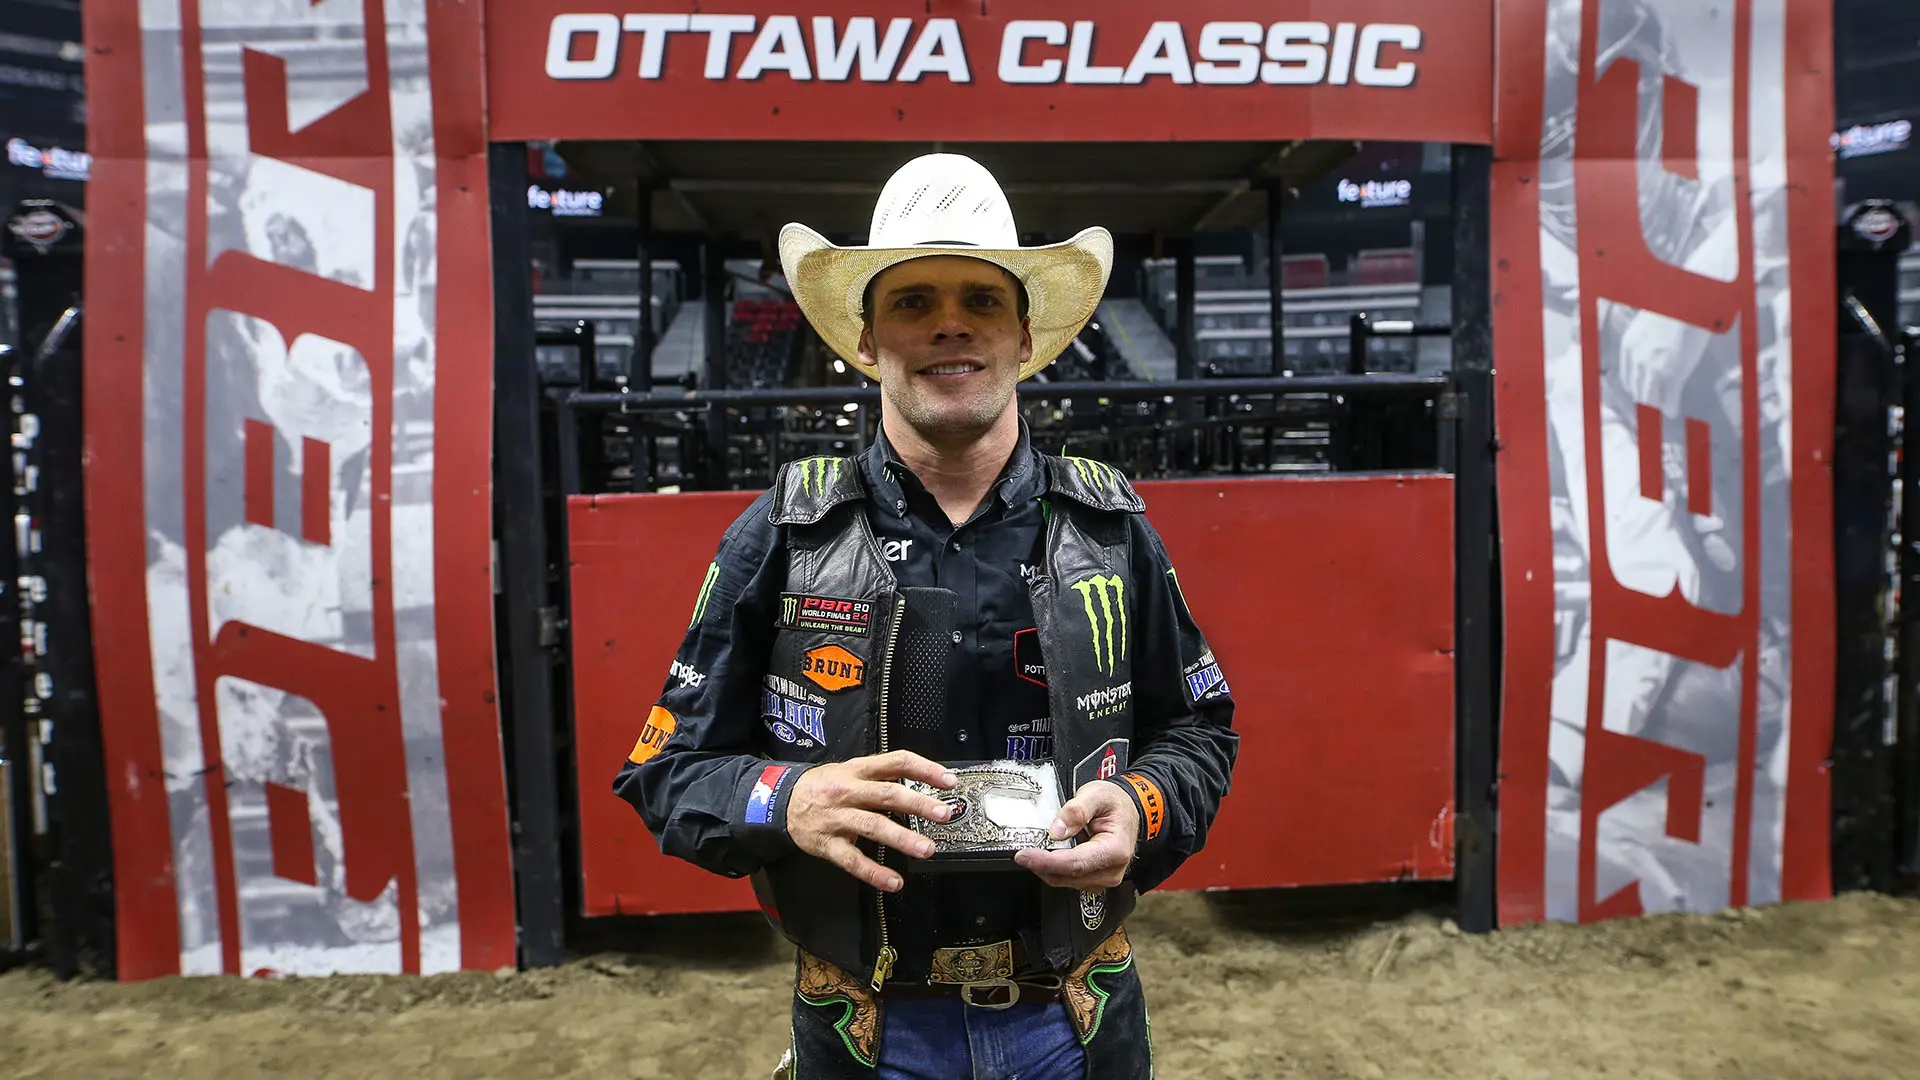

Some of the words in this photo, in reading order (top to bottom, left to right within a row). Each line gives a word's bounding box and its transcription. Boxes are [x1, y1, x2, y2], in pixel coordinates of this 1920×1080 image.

[545, 13, 971, 83] OTTAWA
[998, 20, 1422, 88] CLASSIC
[801, 609, 826, 618] WORLD
[826, 611, 851, 621] FINALS
[852, 612, 869, 621] 24
[803, 597, 853, 613] PBR
[854, 603, 870, 613] 20
[800, 621, 830, 630] UNLEASH
[844, 626, 867, 634] BEAST
[802, 656, 864, 681] BRUNT
[1076, 681, 1132, 711] MONSTER
[1089, 700, 1128, 721] ENERGY
